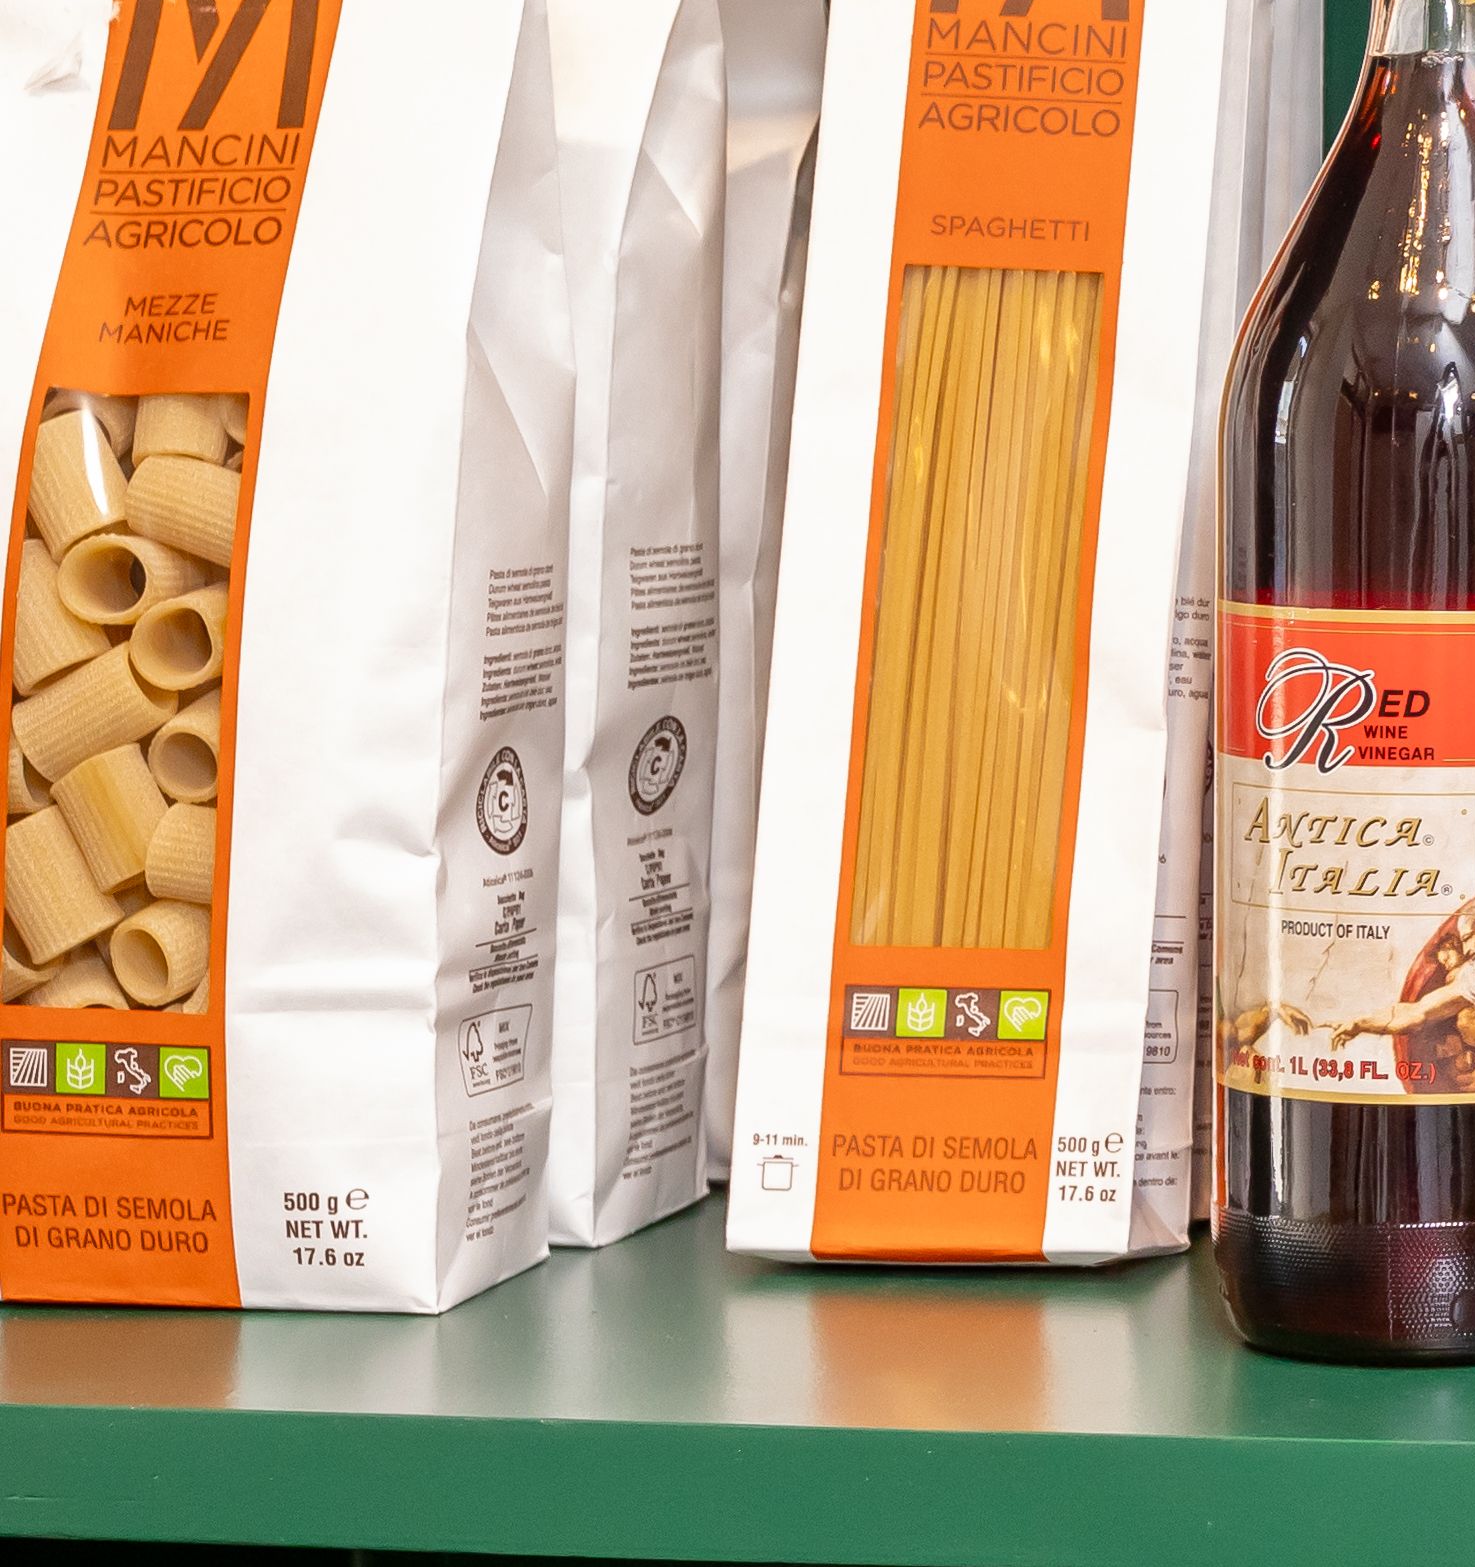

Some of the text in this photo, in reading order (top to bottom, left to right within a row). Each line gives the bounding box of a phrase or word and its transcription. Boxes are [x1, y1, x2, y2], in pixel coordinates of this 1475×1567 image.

[926, 17, 1126, 58] MANCINI
[924, 61, 1124, 97] PASTIFICIO
[919, 102, 1120, 137] AGRICOLO
[102, 133, 299, 168] MANCINI
[94, 176, 290, 207] PASTIFICIO
[83, 218, 283, 249] AGRICOLO
[930, 215, 1089, 242] SPAGHETTI
[124, 294, 217, 318] MEZZE
[98, 320, 230, 345] MANICHE
[1256, 647, 1431, 774] RED
[1364, 725, 1408, 739] WINE
[1359, 746, 1435, 761] VINEGAR
[1245, 796, 1423, 848] ANTICA
[1281, 920, 1390, 940] PRODUCT OF ITALY
[1290, 1056, 1307, 1075] 1L
[753, 1134, 808, 1147] 9-11 min.
[2, 1194, 217, 1222] PASTA DI SEMOLA
[283, 1190, 339, 1215] 500 g
[15, 1225, 209, 1255] DI GRANO DURO
[286, 1220, 368, 1239] NET WT.
[294, 1246, 364, 1267] 17.6 oz
